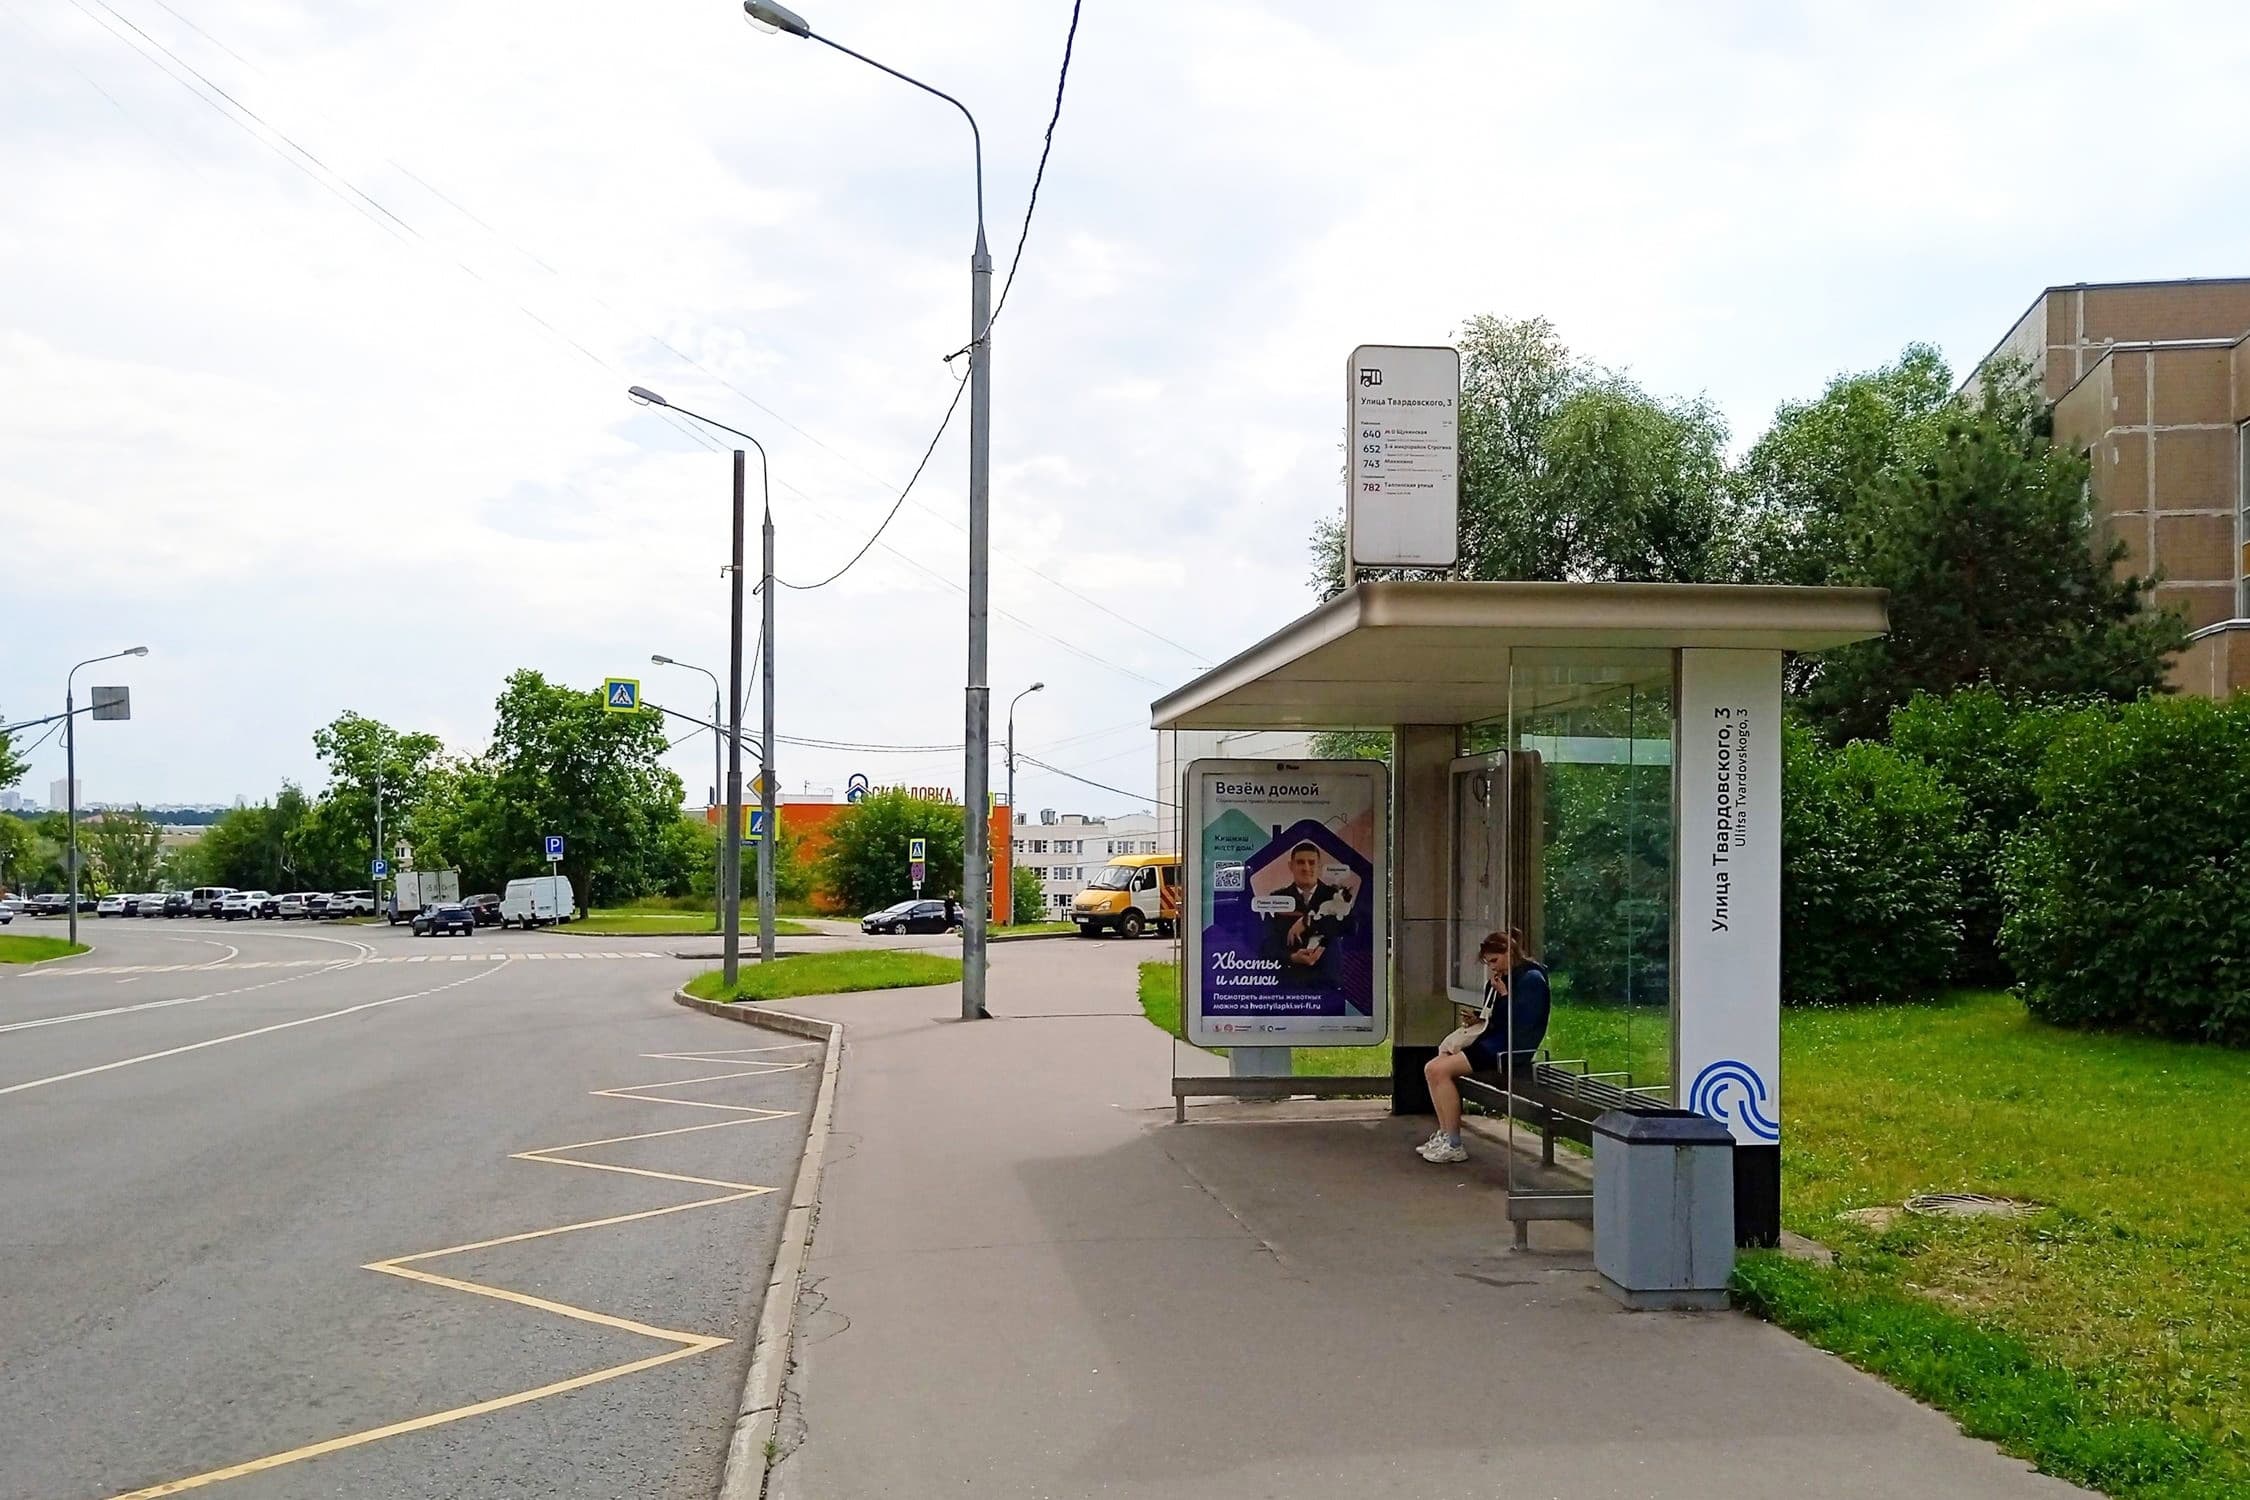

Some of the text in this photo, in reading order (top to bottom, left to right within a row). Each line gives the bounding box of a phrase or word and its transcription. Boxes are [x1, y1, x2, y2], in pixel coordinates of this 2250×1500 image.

[1360, 397, 1453, 408] Улица Твардовского, 3
[1362, 430, 1381, 439] 640
[1363, 445, 1381, 454] 652
[1363, 459, 1380, 468] 743
[1363, 483, 1381, 492] 782
[1735, 708, 1750, 847] Ulitsa Tvardovskogo, 3
[1215, 780, 1319, 797] Везём домой
[1712, 707, 1733, 932] Улица Твардовского, 3
[550, 838, 560, 851] P
[1212, 950, 1282, 970] Хвосты
[1216, 974, 1280, 986] и лапки
[1213, 992, 1258, 1001] Посмотреть
